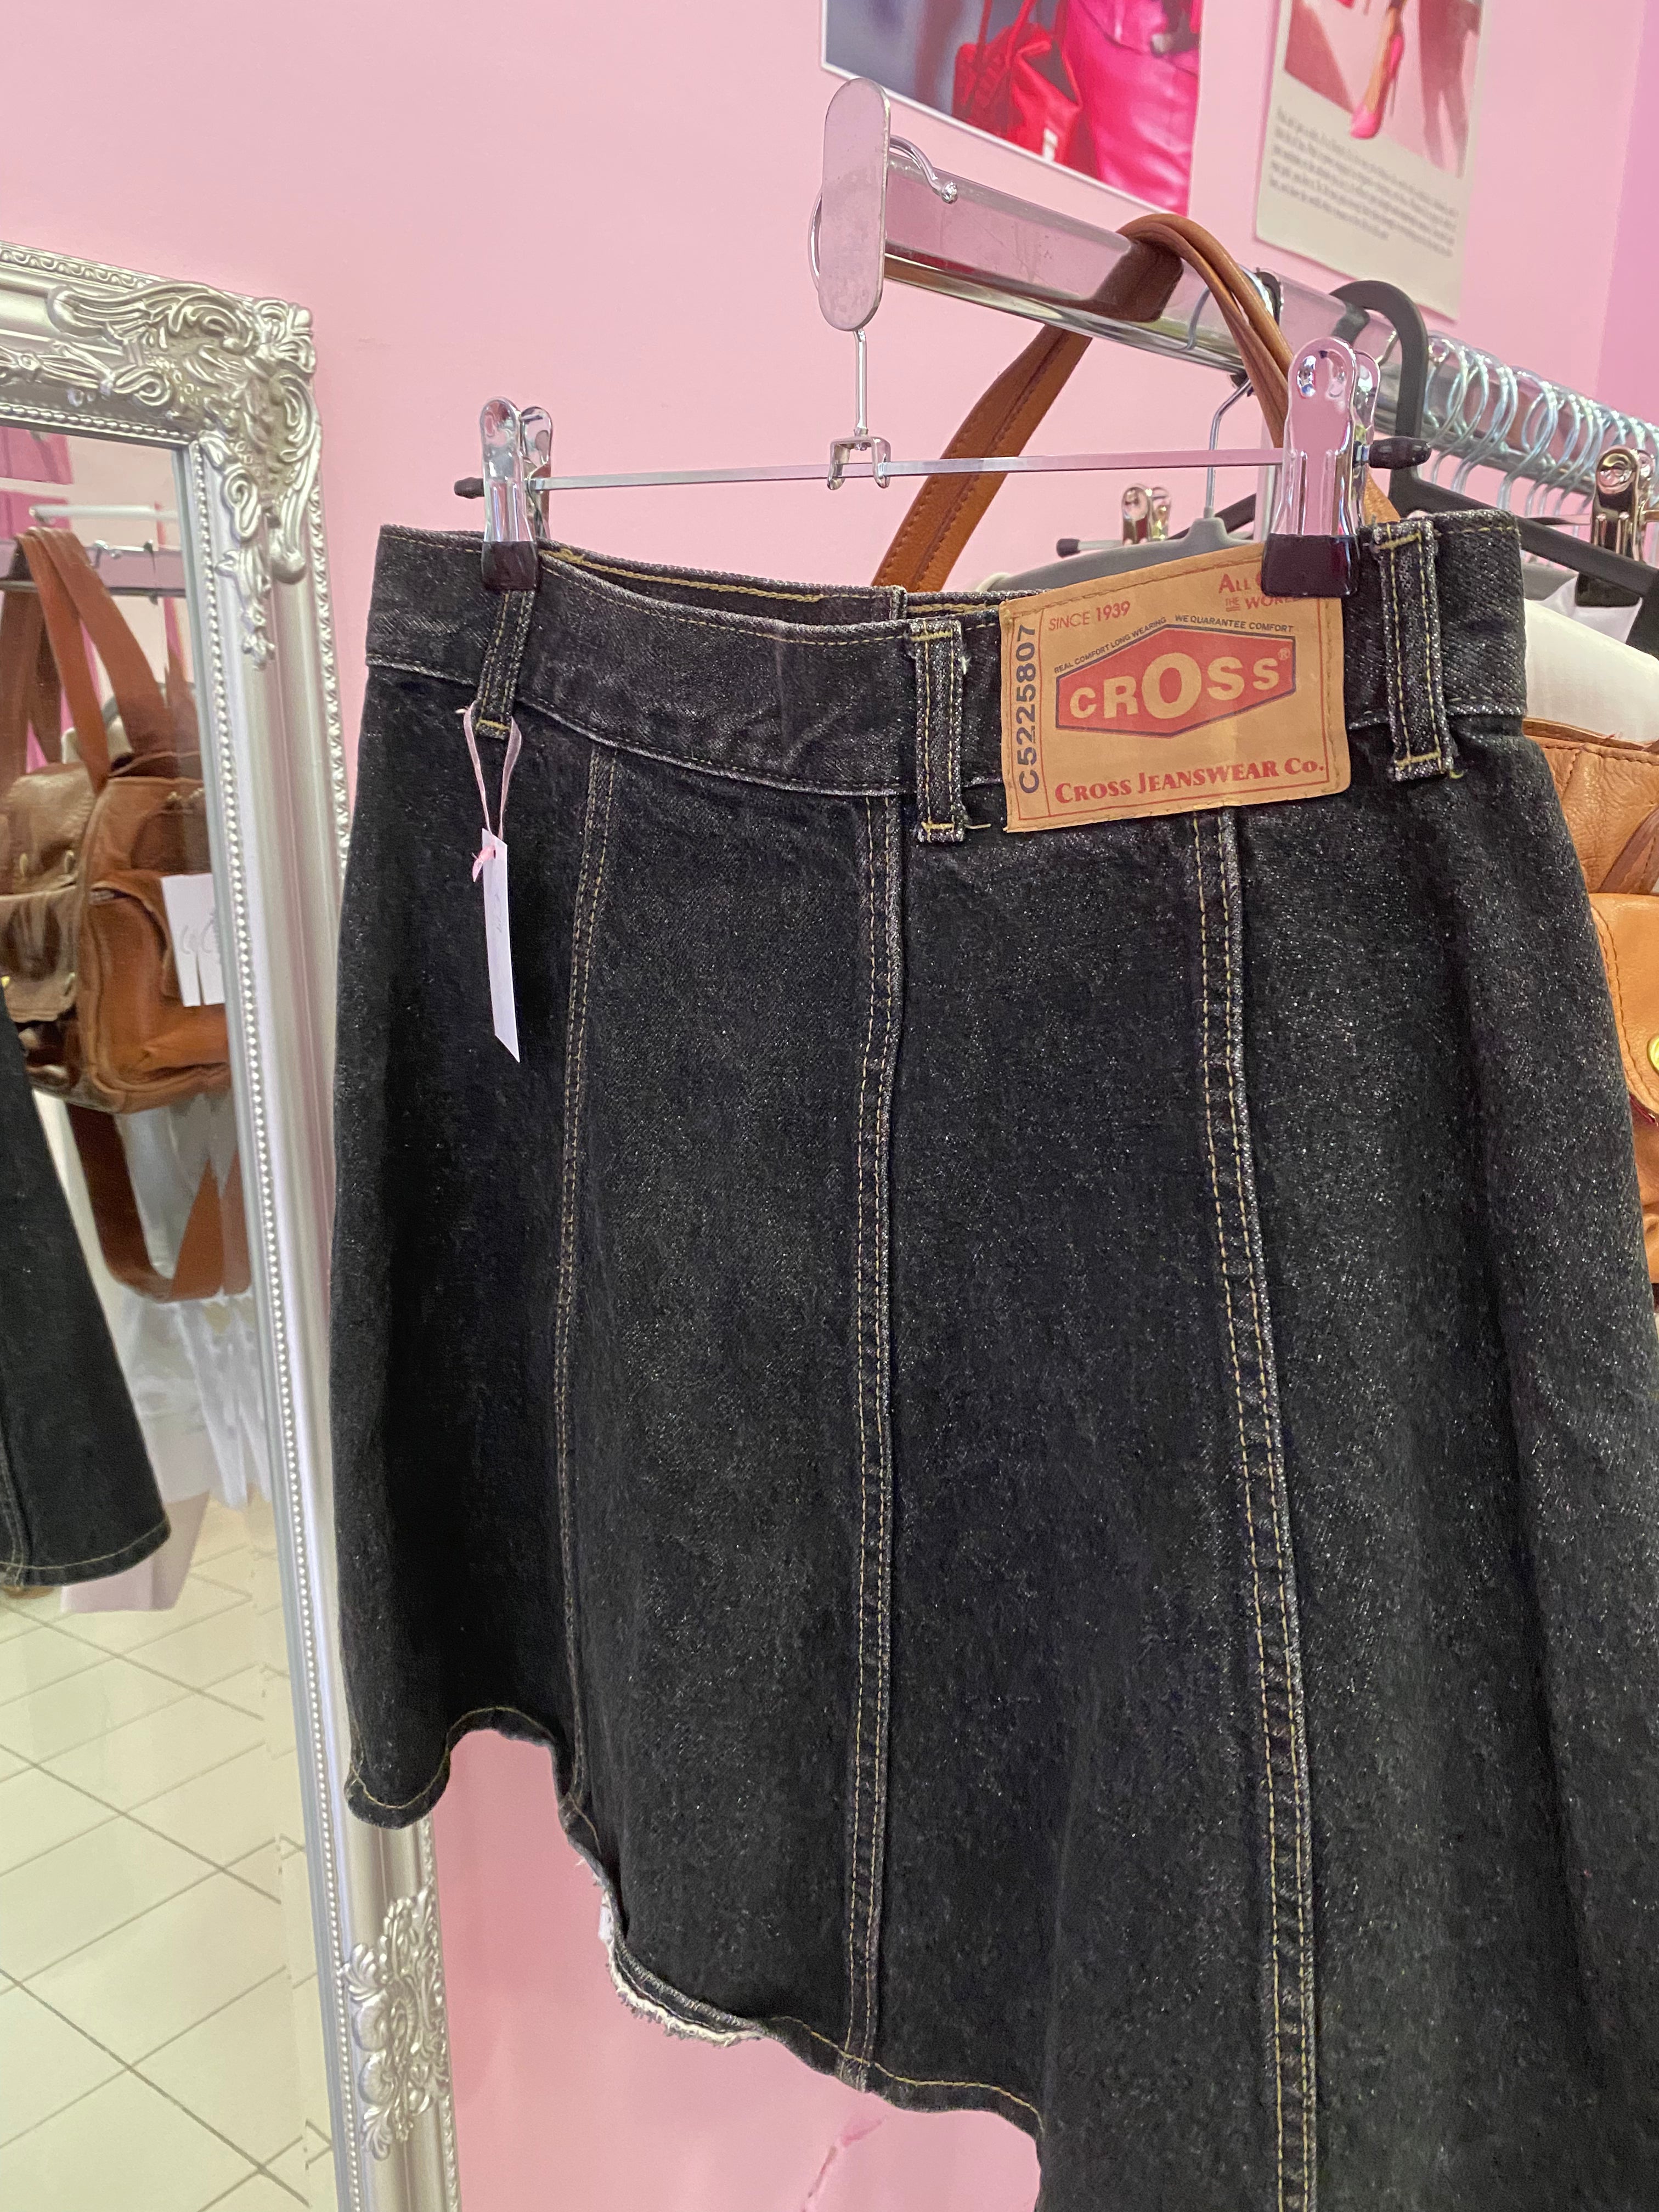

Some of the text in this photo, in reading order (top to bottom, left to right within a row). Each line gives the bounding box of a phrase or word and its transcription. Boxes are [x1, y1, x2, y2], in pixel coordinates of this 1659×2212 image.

[1218, 573, 1250, 593] ALL
[1048, 601, 1131, 631] SINCE 1939
[1244, 595, 1301, 610] WOR
[1175, 614, 1189, 623] WE
[1249, 622, 1294, 633] COMFORT
[1054, 616, 1167, 674] REAL COMFORT LONG WEARING
[1070, 652, 1280, 719] CROSS
[1015, 624, 1040, 794] C5225807
[1054, 779, 1132, 804] CROSS
[1136, 760, 1280, 794] JEANSWEAR
